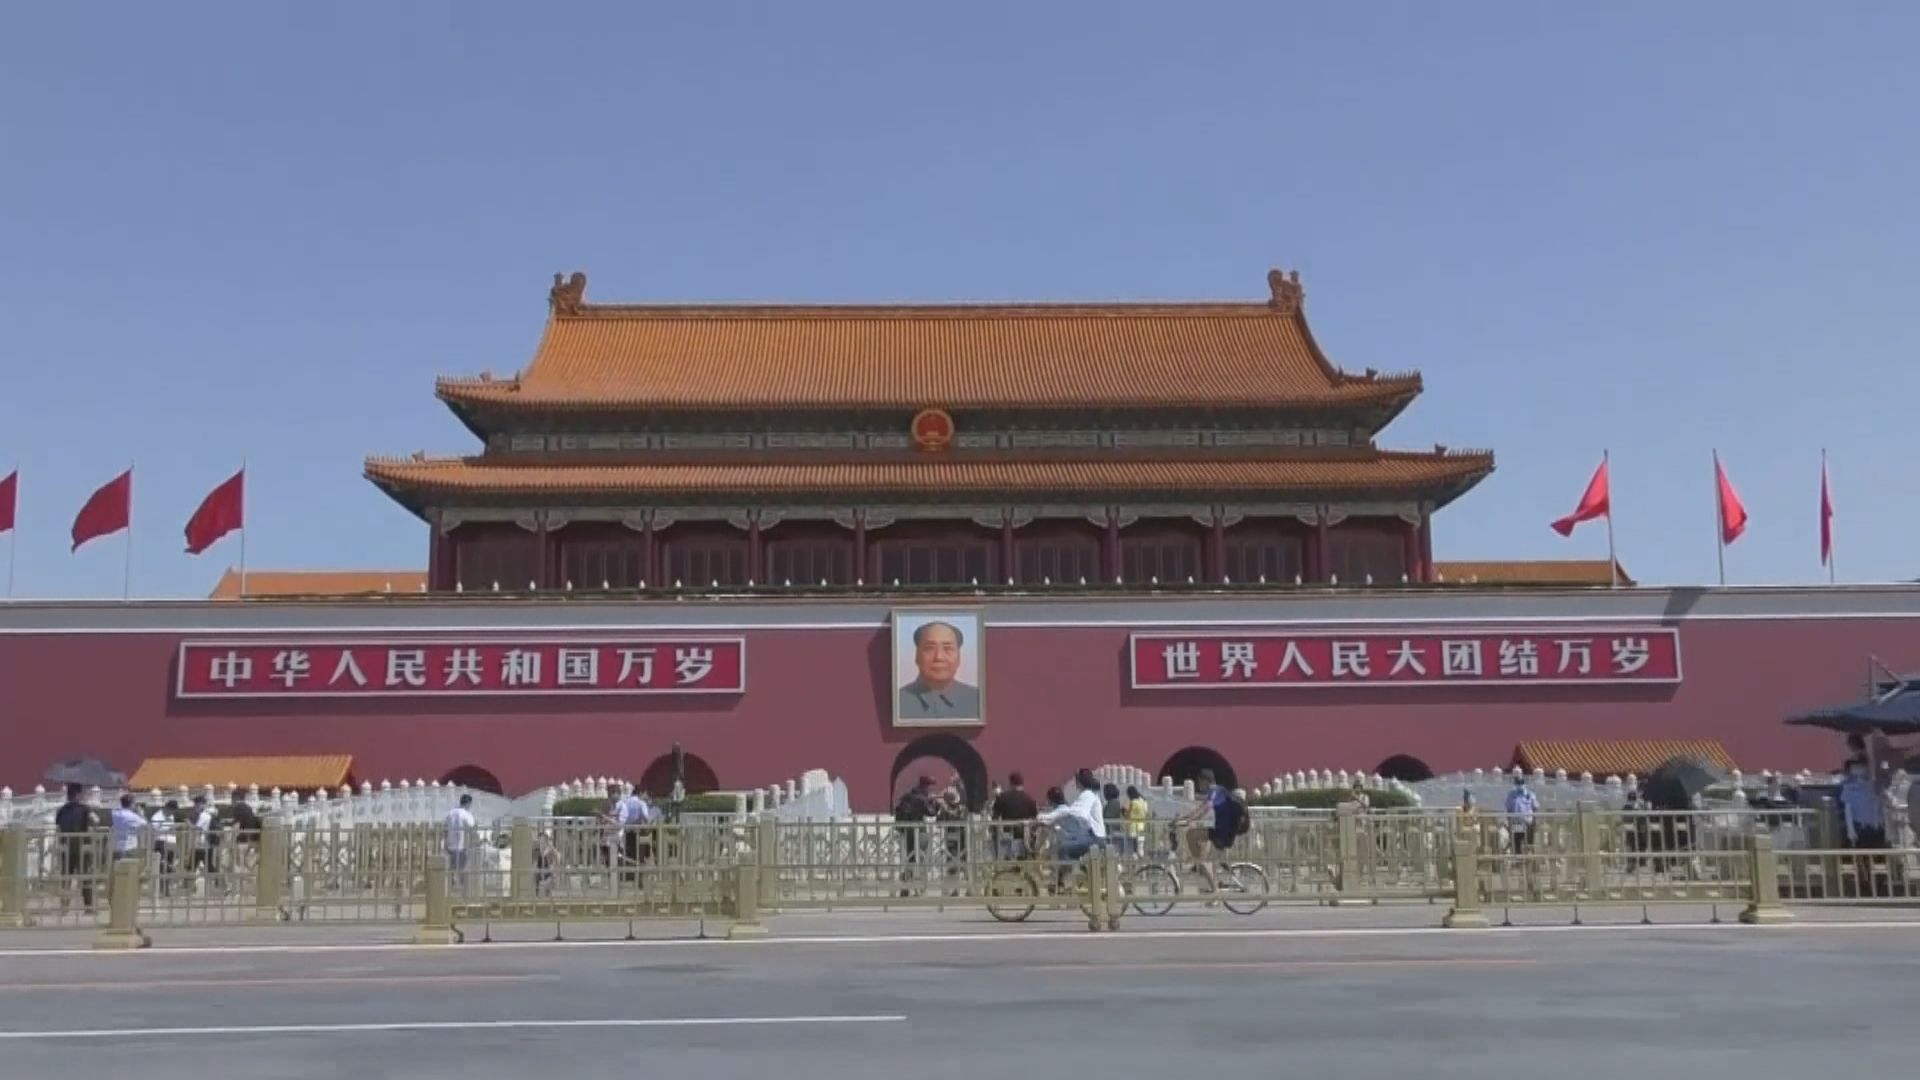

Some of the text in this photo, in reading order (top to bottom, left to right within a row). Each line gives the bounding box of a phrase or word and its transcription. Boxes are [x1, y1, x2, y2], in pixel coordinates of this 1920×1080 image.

[210, 647, 715, 688] 中华人民共和国万岁
[1163, 637, 1651, 678] 世界人民大团结万岁
